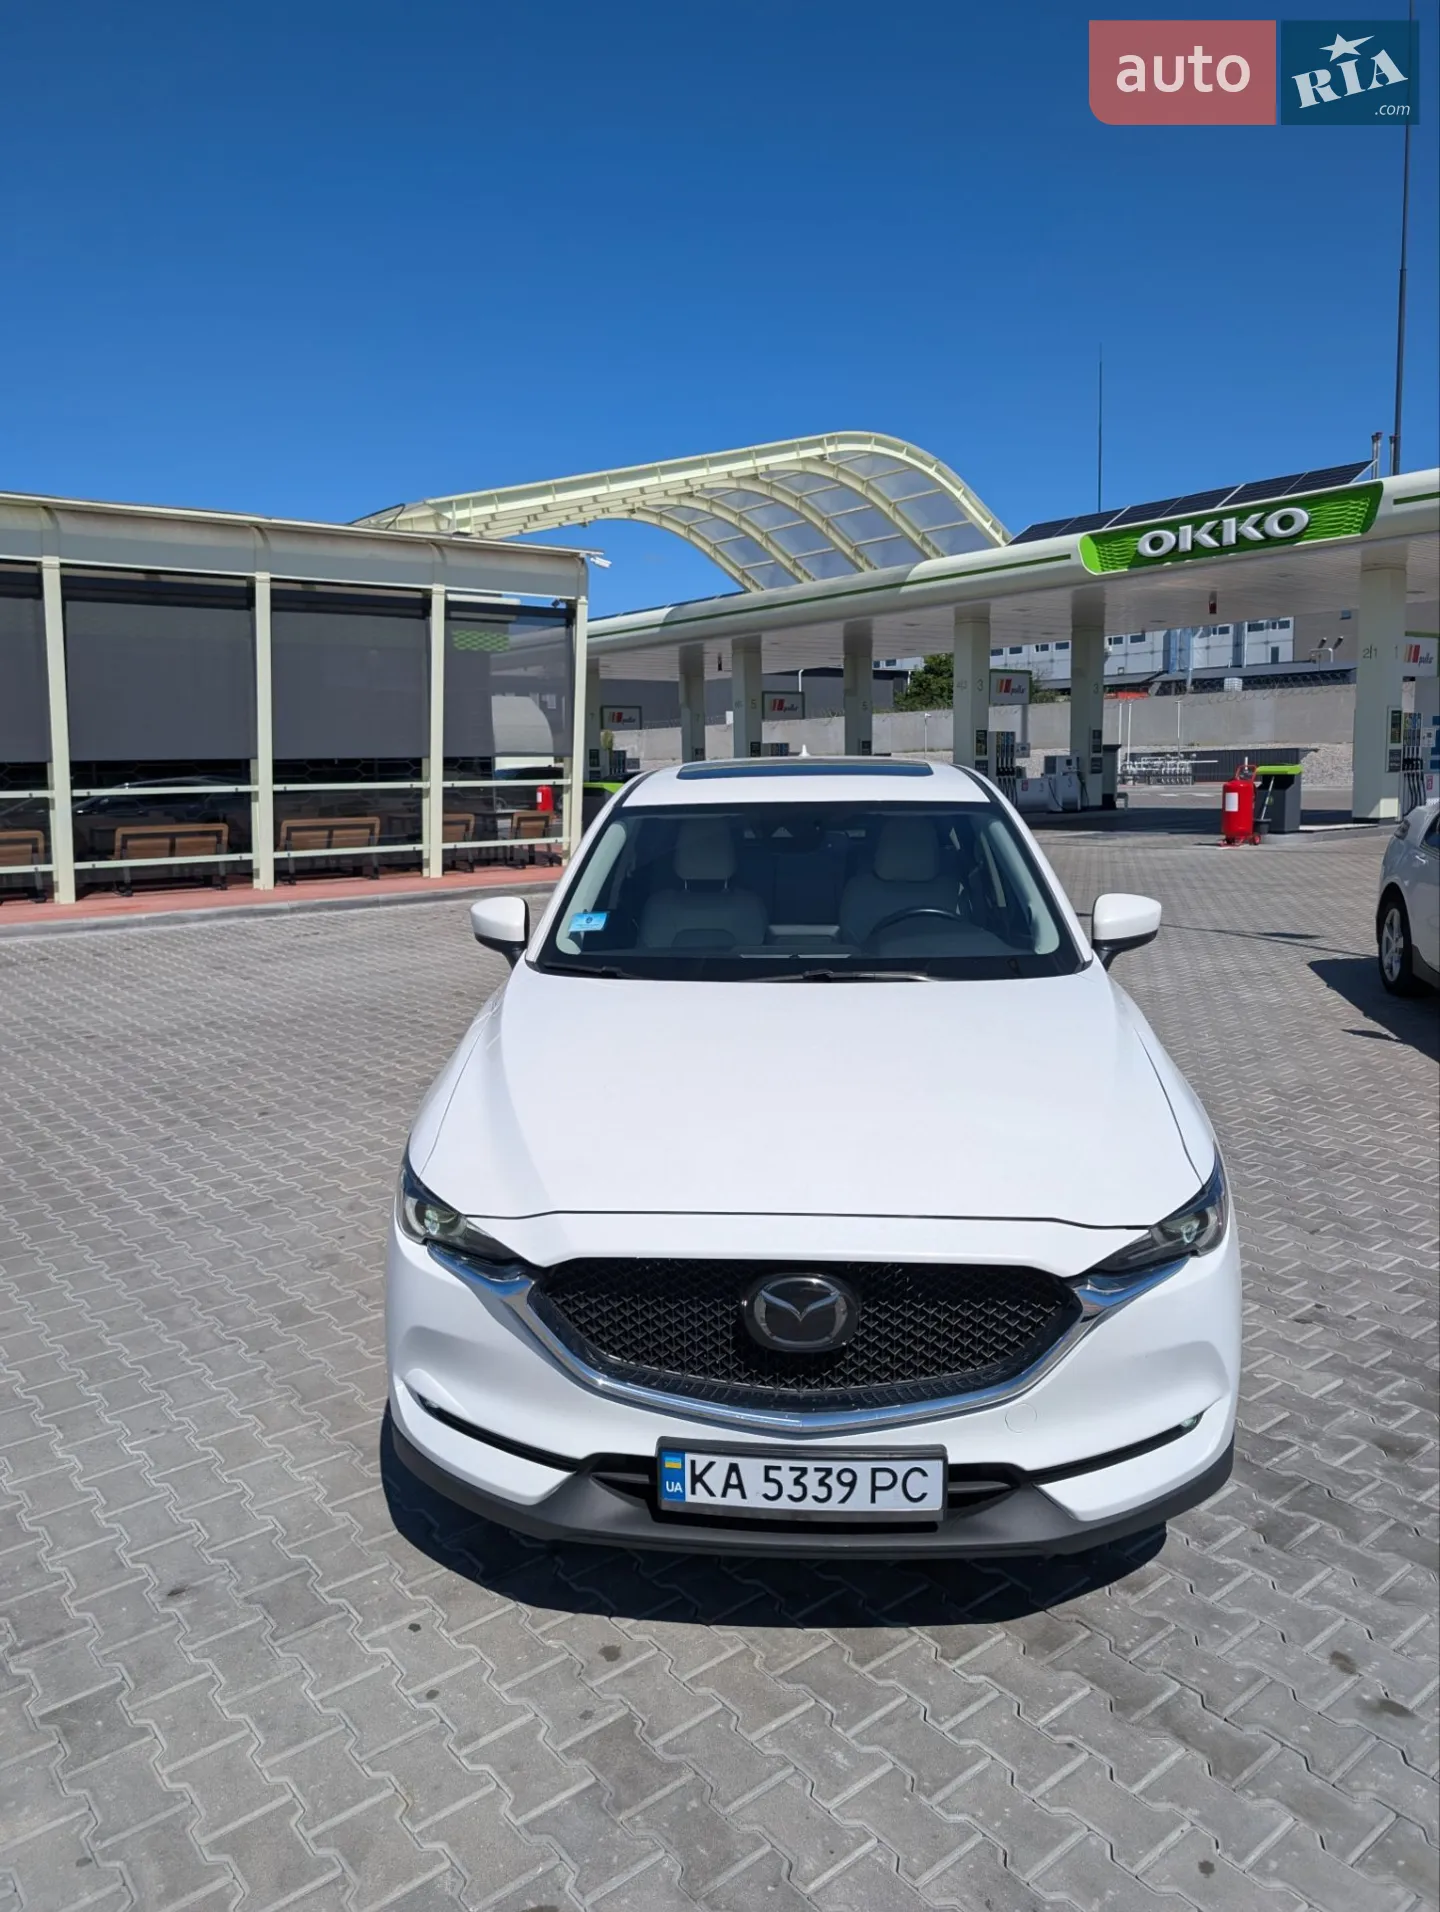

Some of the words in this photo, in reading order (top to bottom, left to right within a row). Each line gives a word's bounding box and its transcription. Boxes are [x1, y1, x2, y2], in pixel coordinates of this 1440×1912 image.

[1137, 506, 1310, 558] OKKO
[976, 678, 984, 691] 3
[1092, 682, 1099, 694] 3
[665, 1480, 683, 1494] UA
[689, 1459, 748, 1500] KA
[761, 1465, 858, 1504] 5339
[869, 1466, 930, 1504] PC
